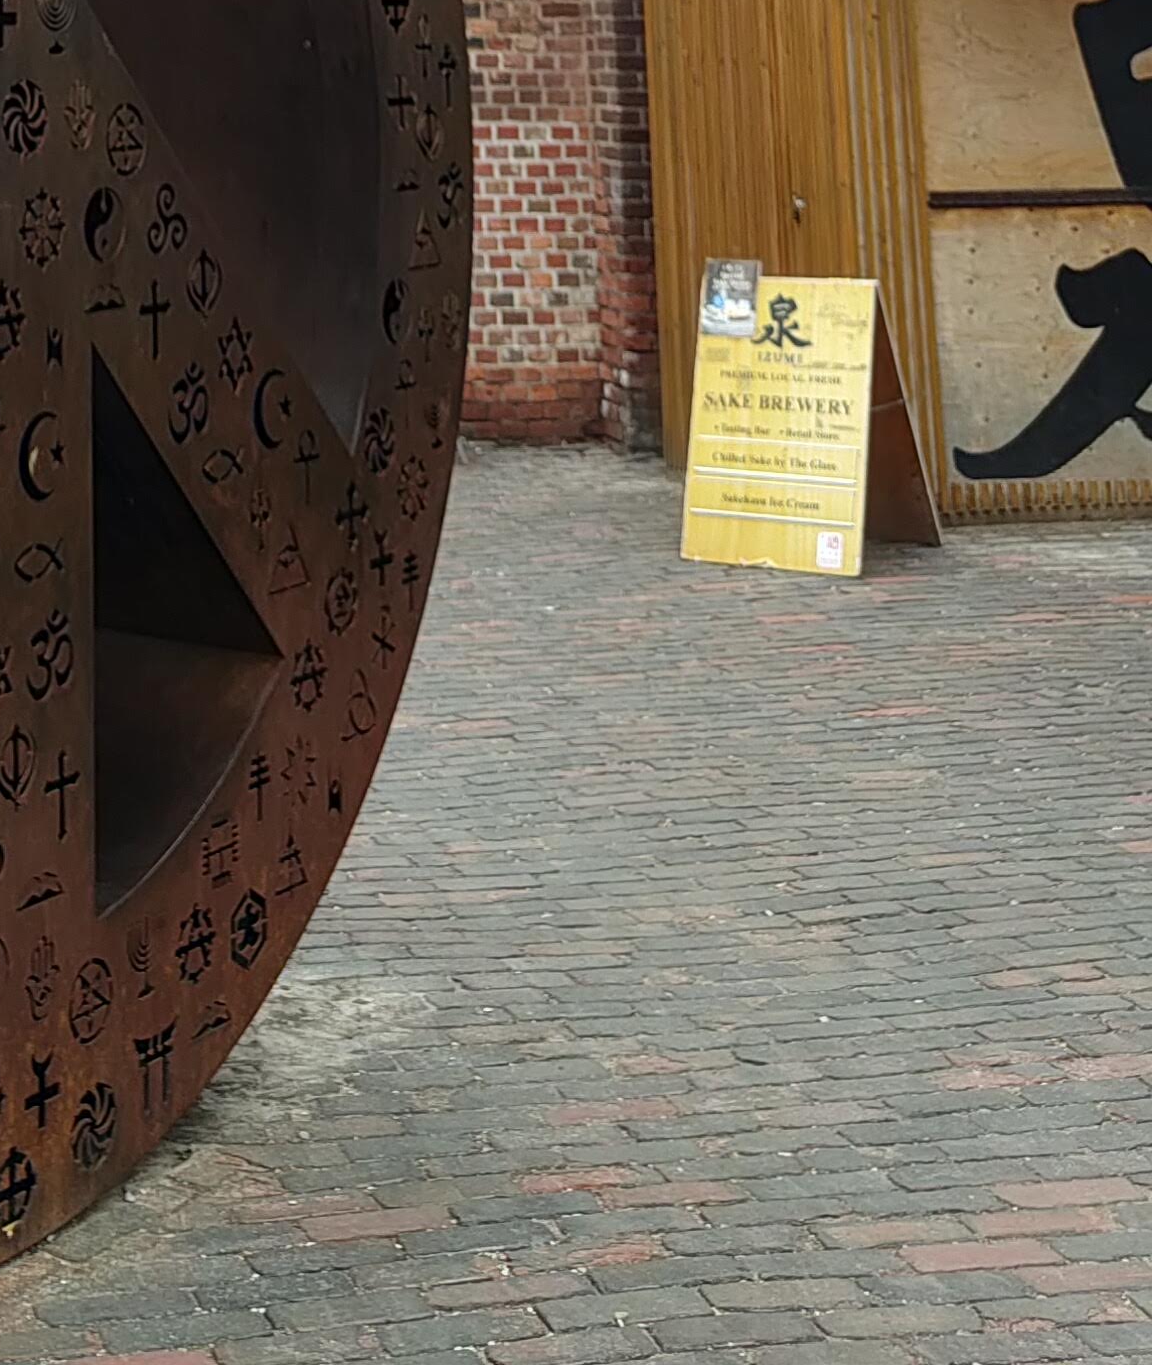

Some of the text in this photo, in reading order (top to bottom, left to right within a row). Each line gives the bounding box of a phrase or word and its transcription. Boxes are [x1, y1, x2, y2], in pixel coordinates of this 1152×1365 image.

[751, 293, 812, 348] 泉
[758, 351, 803, 365] IZUMI
[704, 391, 854, 416] SAKE BREWERY
[712, 451, 746, 464] Chilled
[749, 453, 772, 465] Sake
[774, 455, 786, 469] by
[790, 457, 807, 468] The
